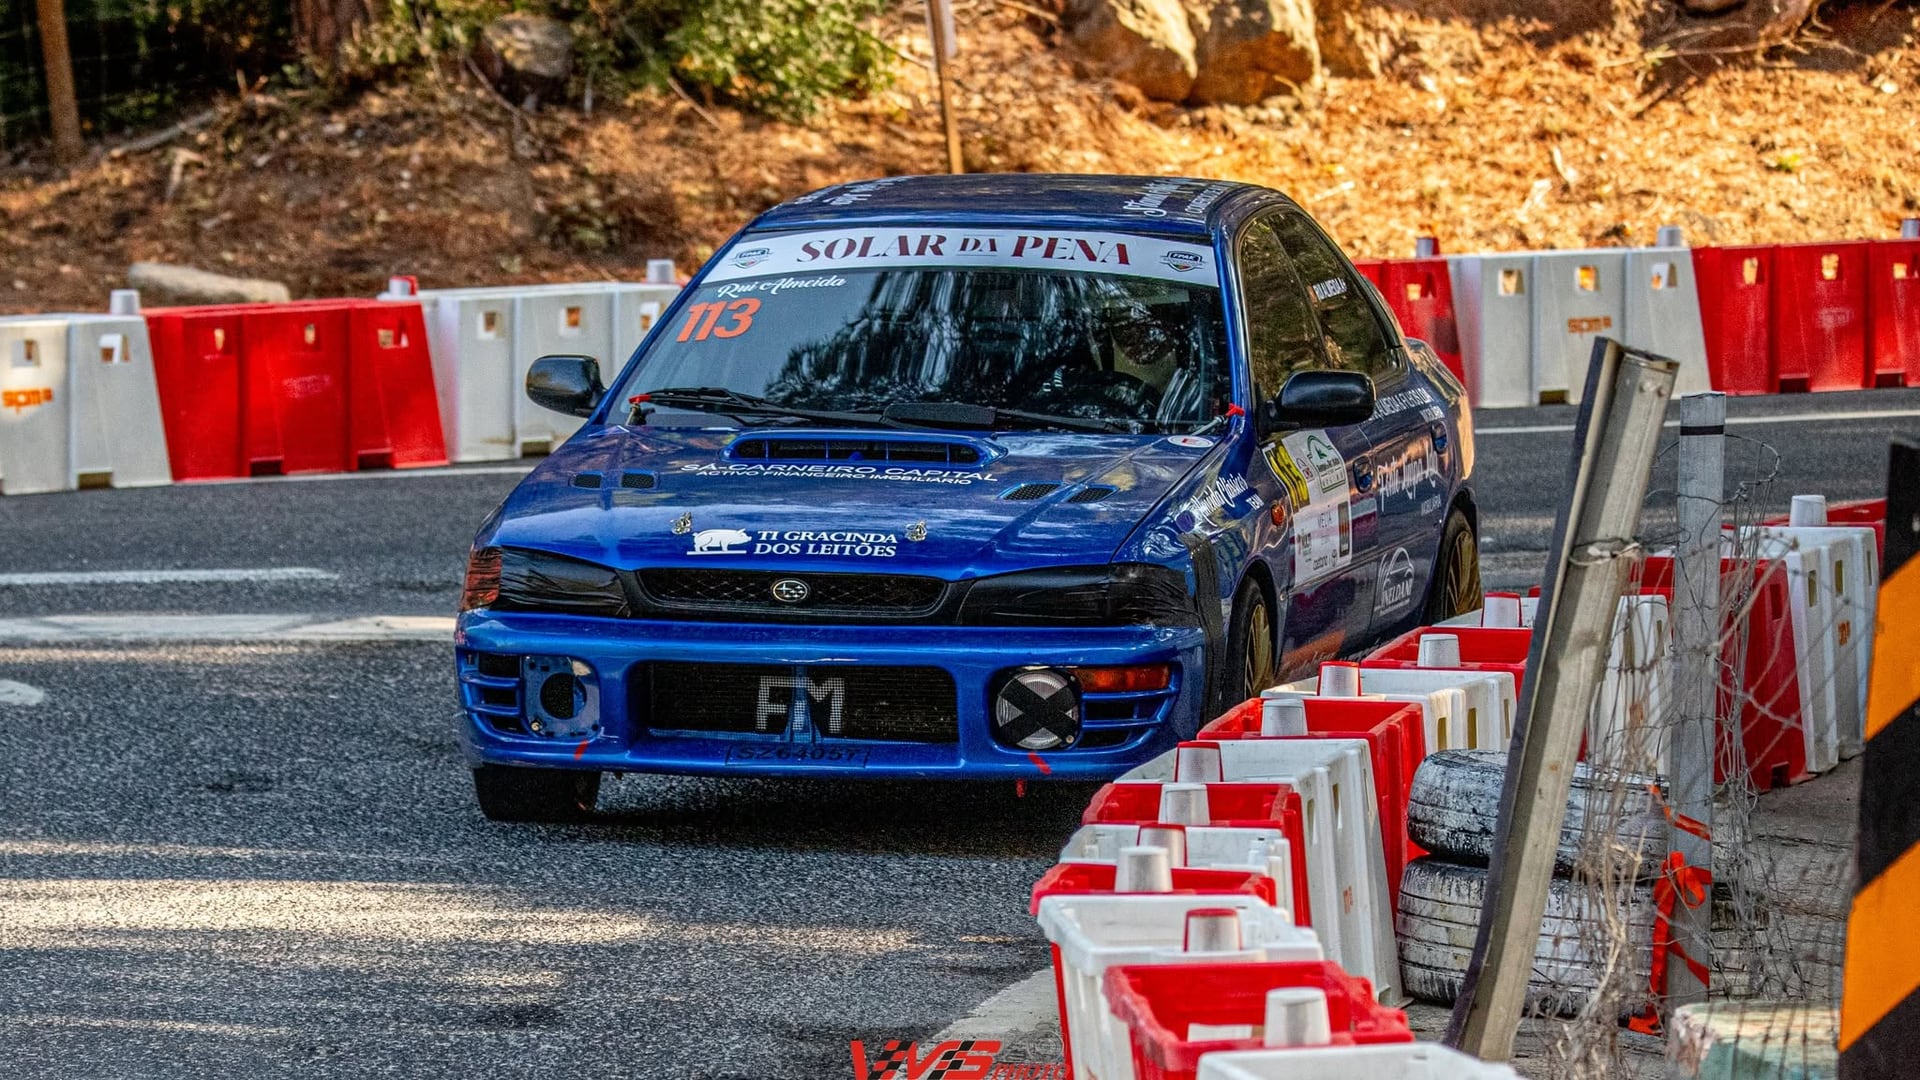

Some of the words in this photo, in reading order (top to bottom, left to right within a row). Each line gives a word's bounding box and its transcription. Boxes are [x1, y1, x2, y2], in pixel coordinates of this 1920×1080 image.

[796, 234, 947, 263] SOLAR
[957, 237, 998, 253] DA
[1011, 235, 1131, 266] PENA
[717, 282, 758, 298] Rui
[759, 275, 847, 295] Almeida
[676, 298, 762, 343] 113
[763, 471, 866, 479] FINANCEIRO
[885, 467, 998, 482] CAPITAL
[758, 530, 780, 541] TI
[784, 531, 898, 543] GRACINDA
[754, 543, 801, 554] DOS
[806, 542, 897, 557] LEITÕES
[755, 675, 845, 733] FM
